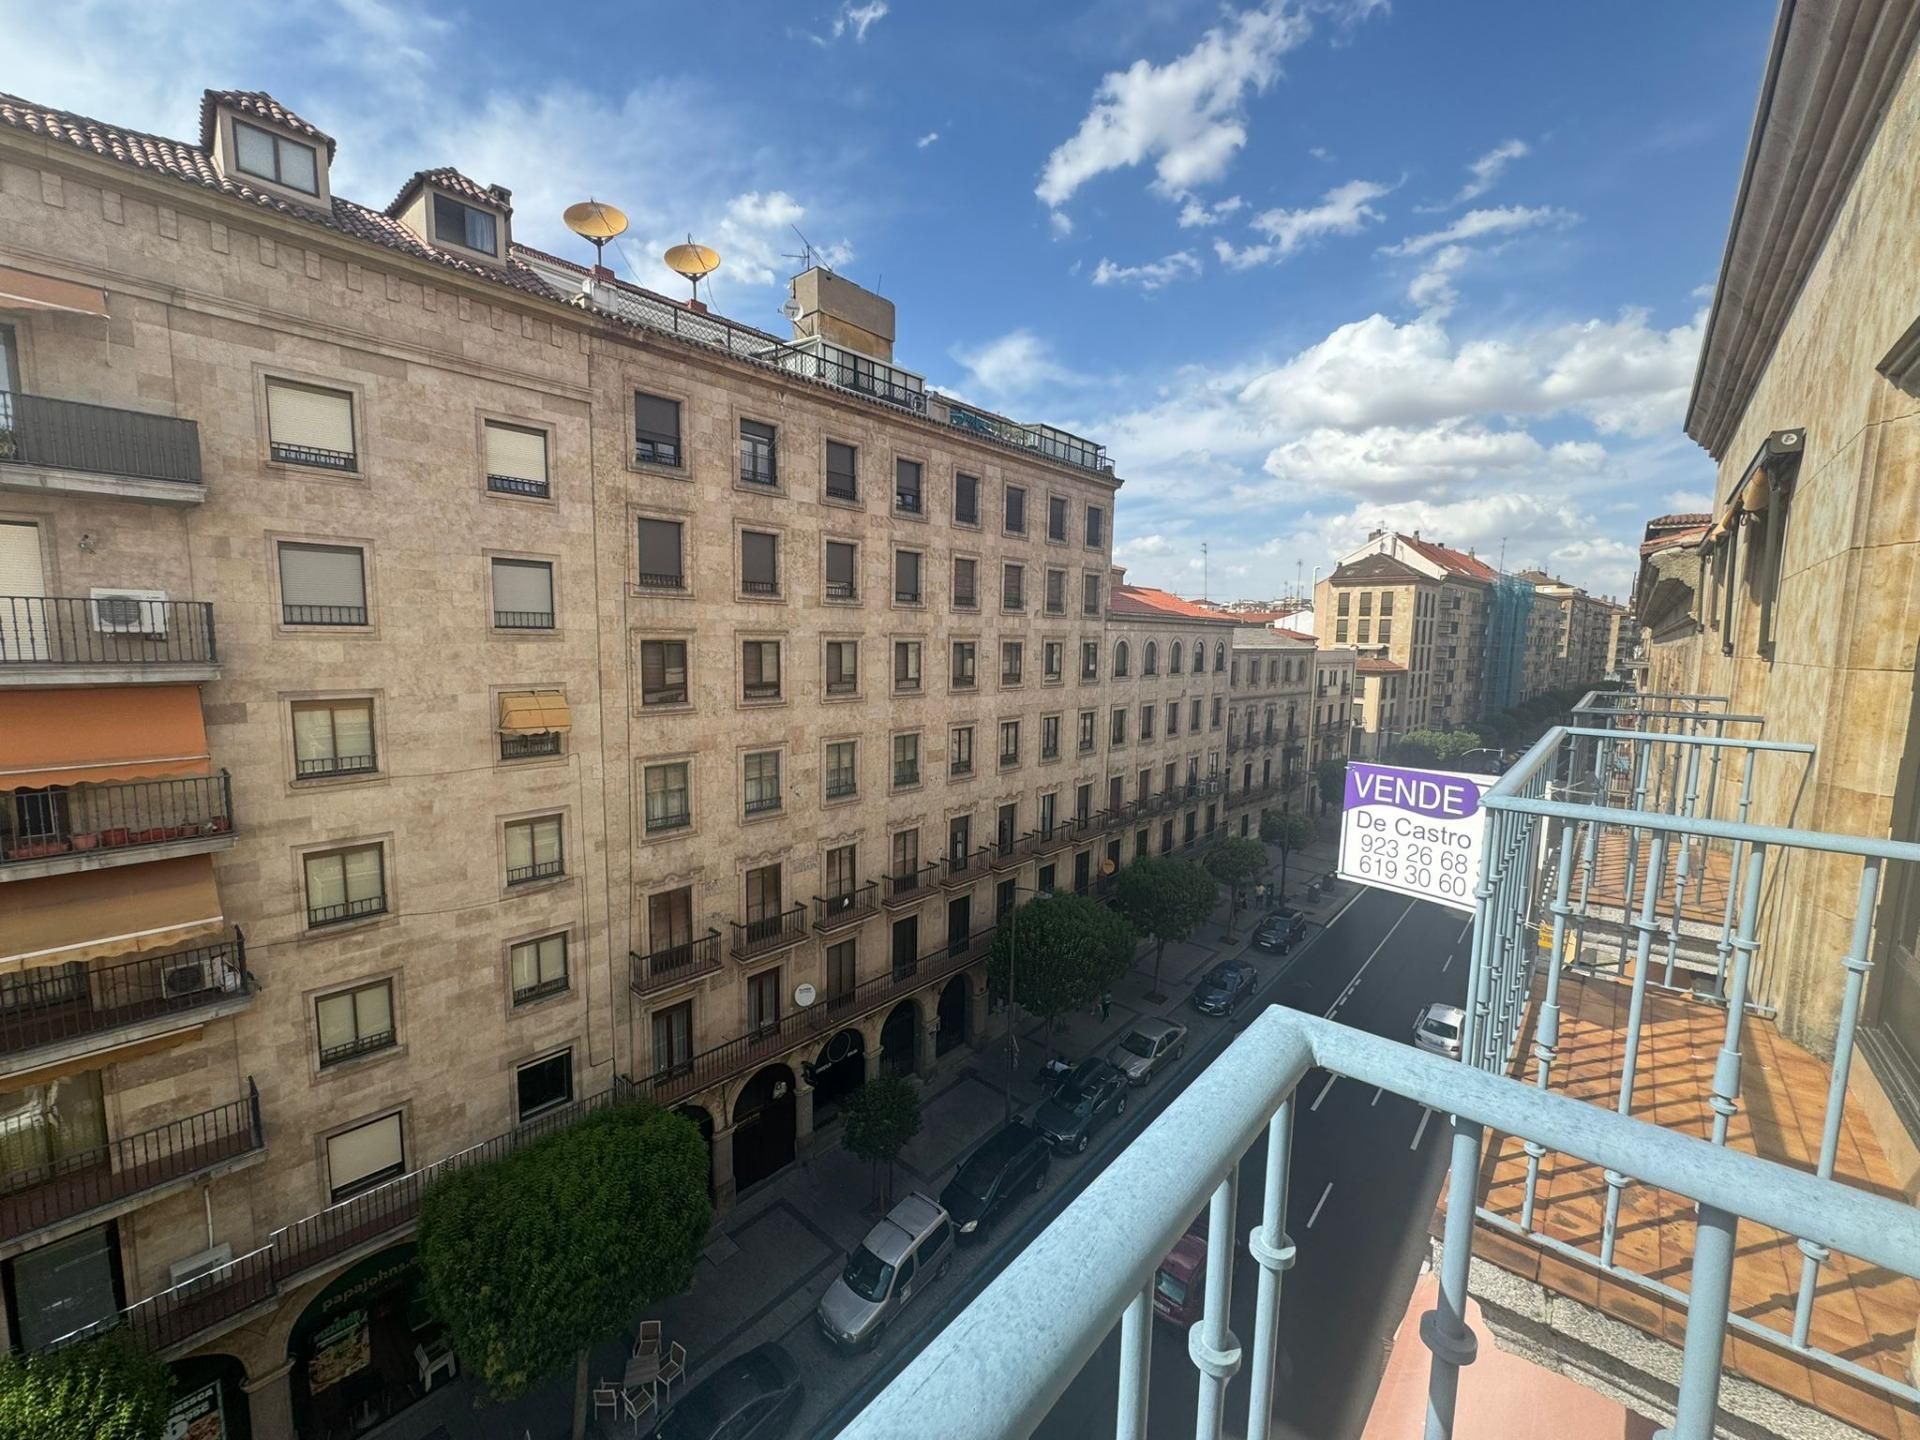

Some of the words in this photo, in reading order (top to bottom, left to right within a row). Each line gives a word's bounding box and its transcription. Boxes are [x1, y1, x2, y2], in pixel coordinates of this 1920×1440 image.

[1354, 771, 1465, 815] VENDE
[1356, 810, 1387, 832] De
[1395, 817, 1472, 850] Castro
[1361, 834, 1399, 859] 923
[1406, 843, 1433, 866] 26
[1440, 850, 1468, 874] 68
[1359, 855, 1398, 880] 619
[1404, 864, 1431, 888] 30
[1439, 873, 1467, 897] 60
